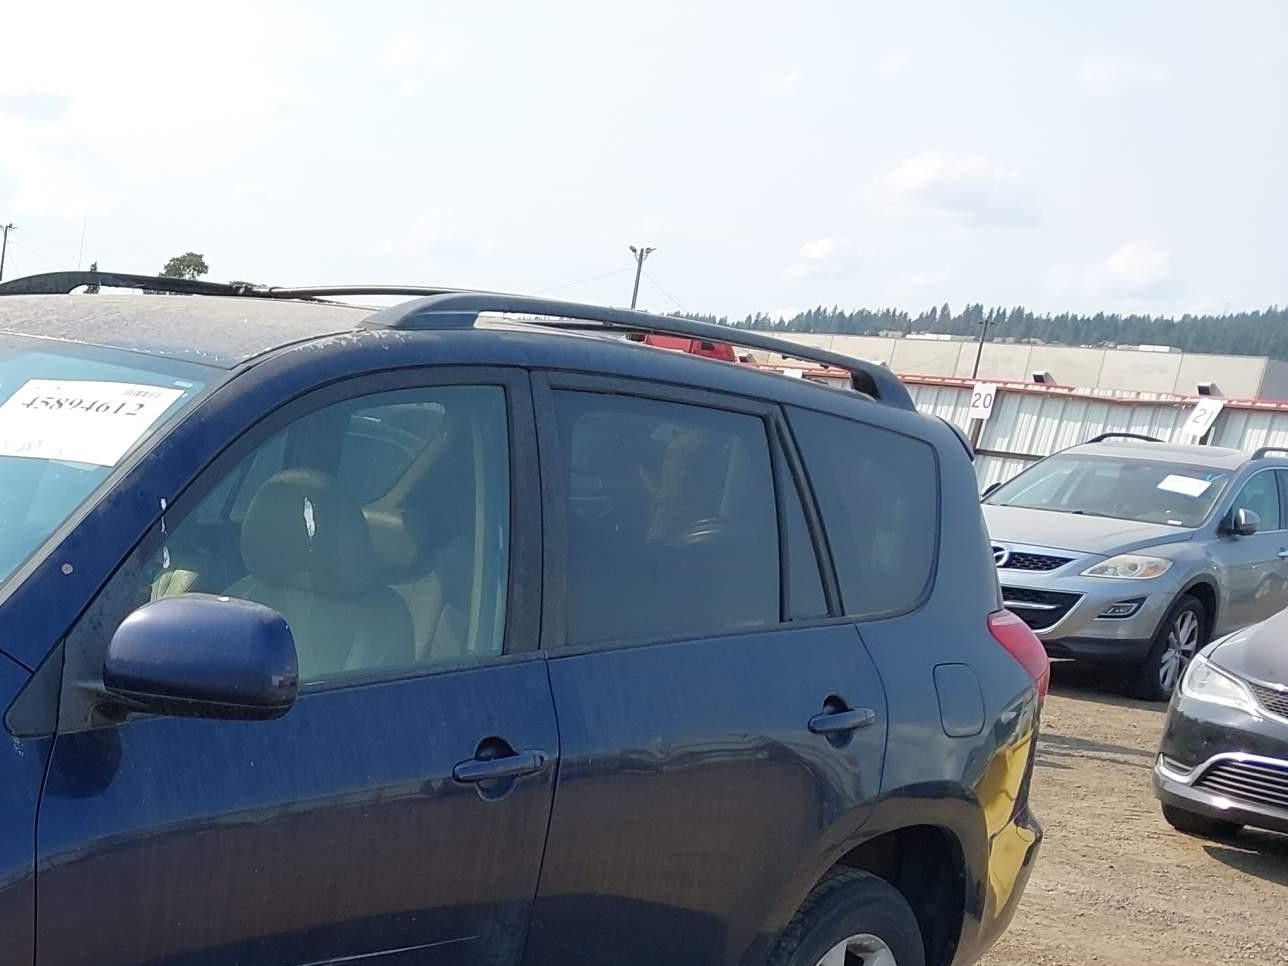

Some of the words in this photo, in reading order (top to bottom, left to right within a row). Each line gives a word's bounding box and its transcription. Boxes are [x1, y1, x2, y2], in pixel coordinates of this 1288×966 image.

[22, 396, 146, 416] 45894612
[971, 393, 993, 409] 20
[1192, 408, 1213, 425] 21
